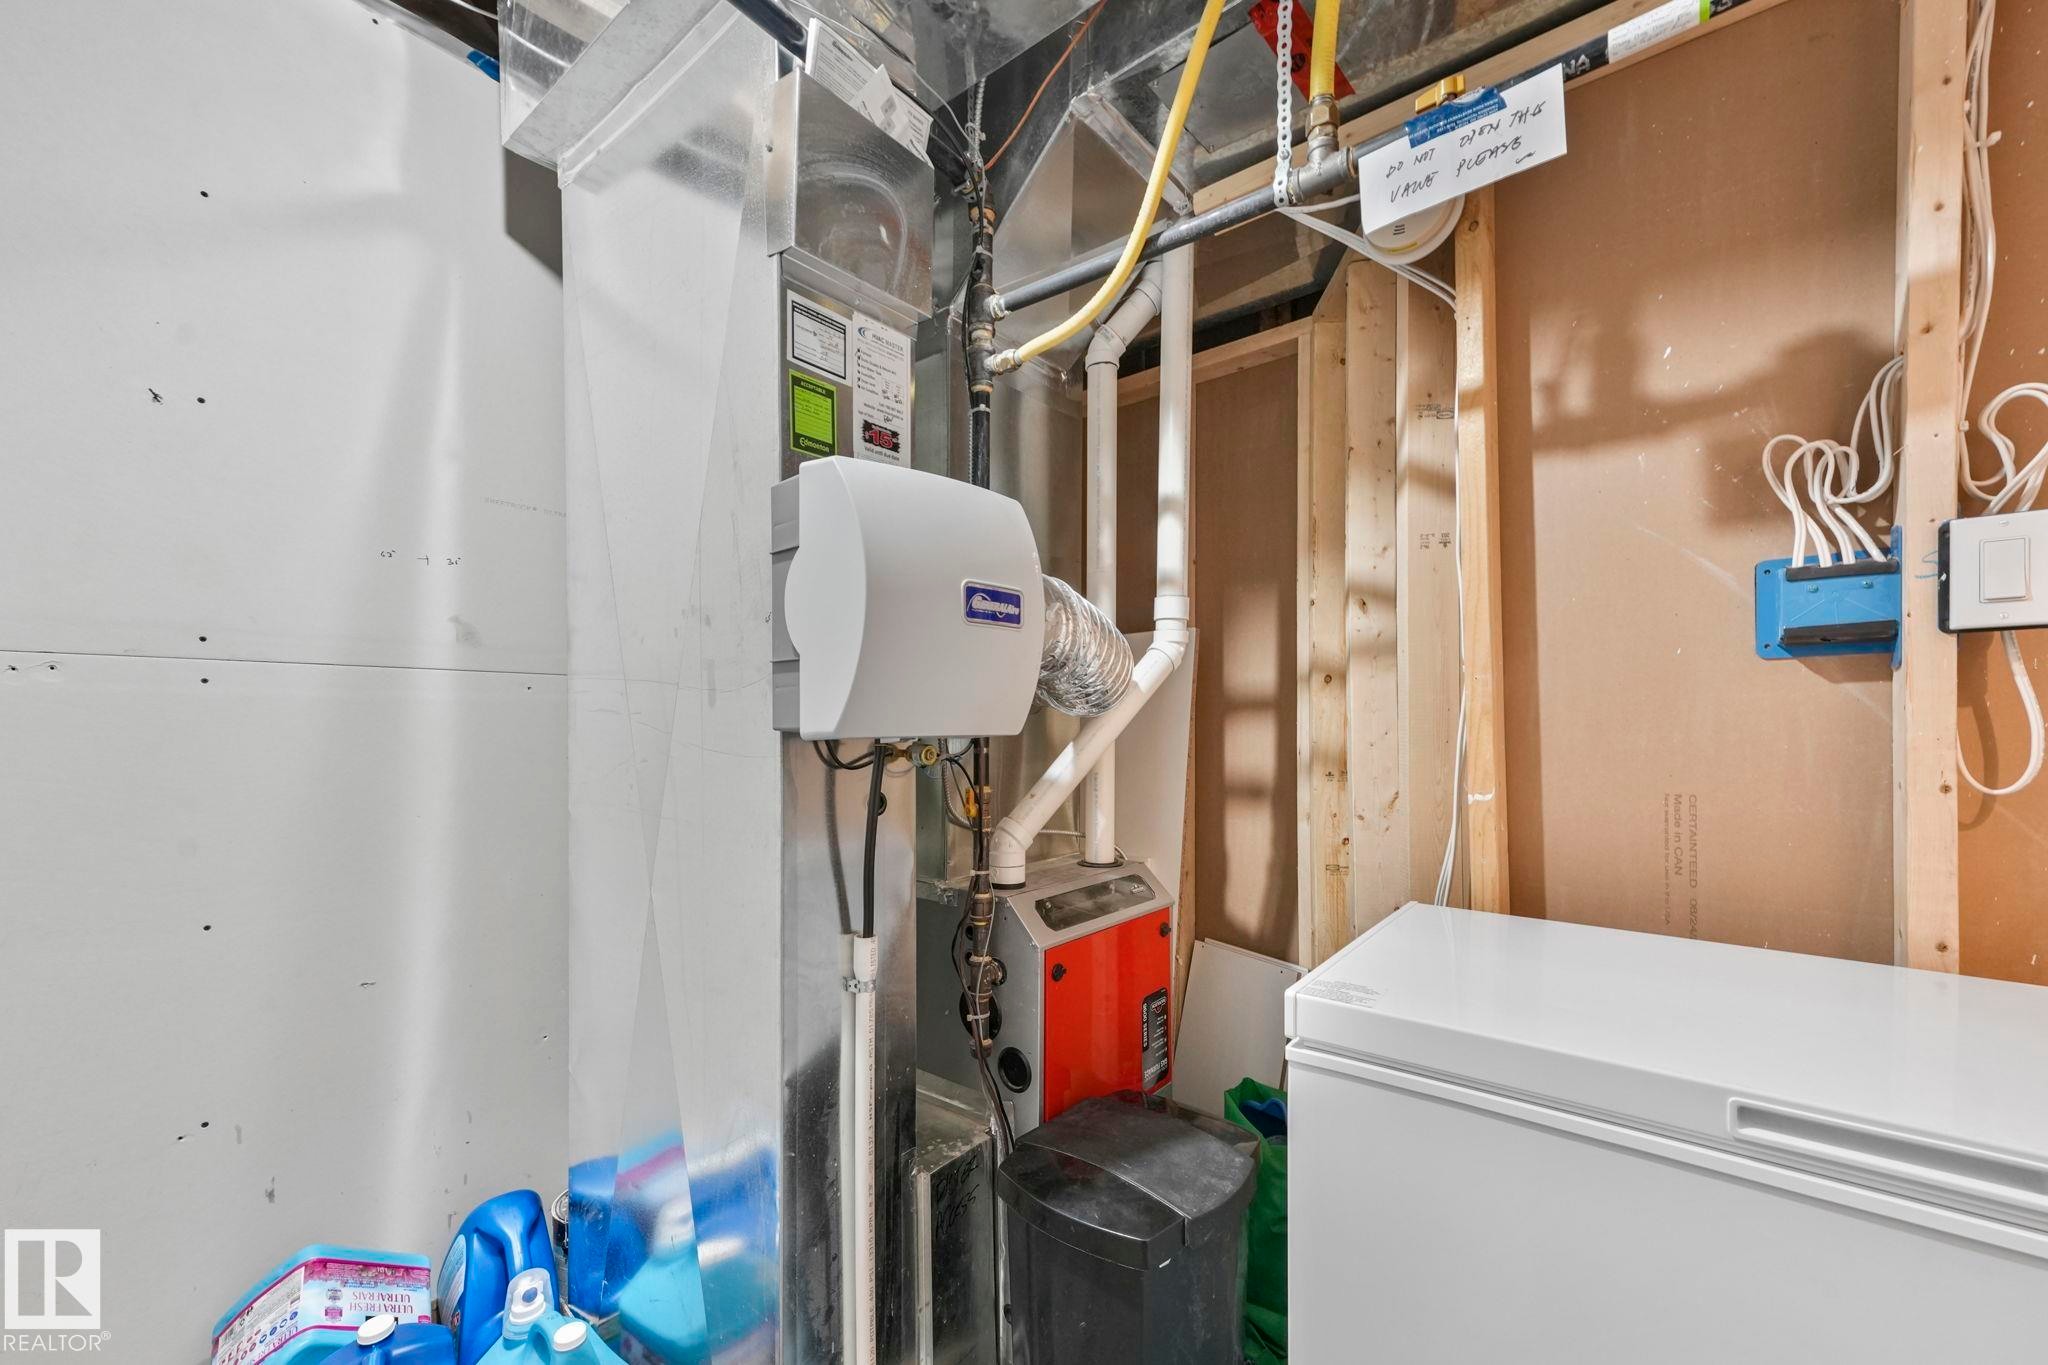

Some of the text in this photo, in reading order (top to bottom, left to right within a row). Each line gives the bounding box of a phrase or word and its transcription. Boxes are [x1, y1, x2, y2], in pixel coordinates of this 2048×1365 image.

[1386, 161, 1405, 179] DO
[1413, 148, 1436, 165] NOT
[1509, 101, 1546, 130] THIS
[1456, 136, 1521, 177] PLEASE
[1673, 793, 1683, 876] Made in CAN
[1688, 793, 1698, 889] CERTAINTEED
[349, 1302, 414, 1314] ULTRA FRESH
